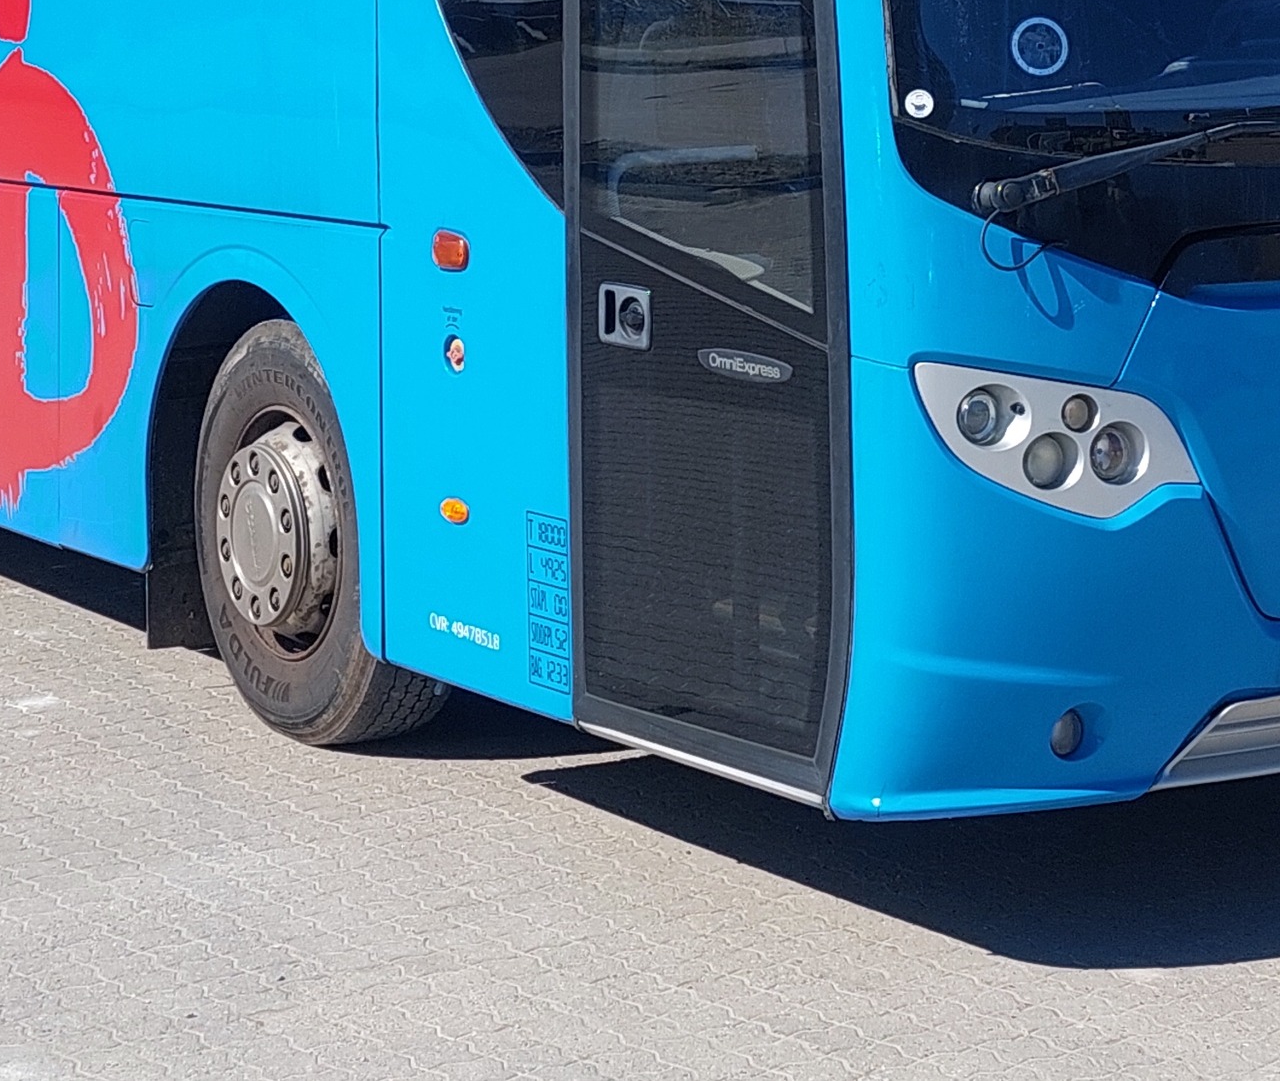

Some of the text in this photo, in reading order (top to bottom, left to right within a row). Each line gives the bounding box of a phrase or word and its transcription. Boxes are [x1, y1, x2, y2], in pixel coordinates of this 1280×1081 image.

[708, 352, 781, 379] OmniExpress
[429, 612, 500, 651] CVR: 49478518
